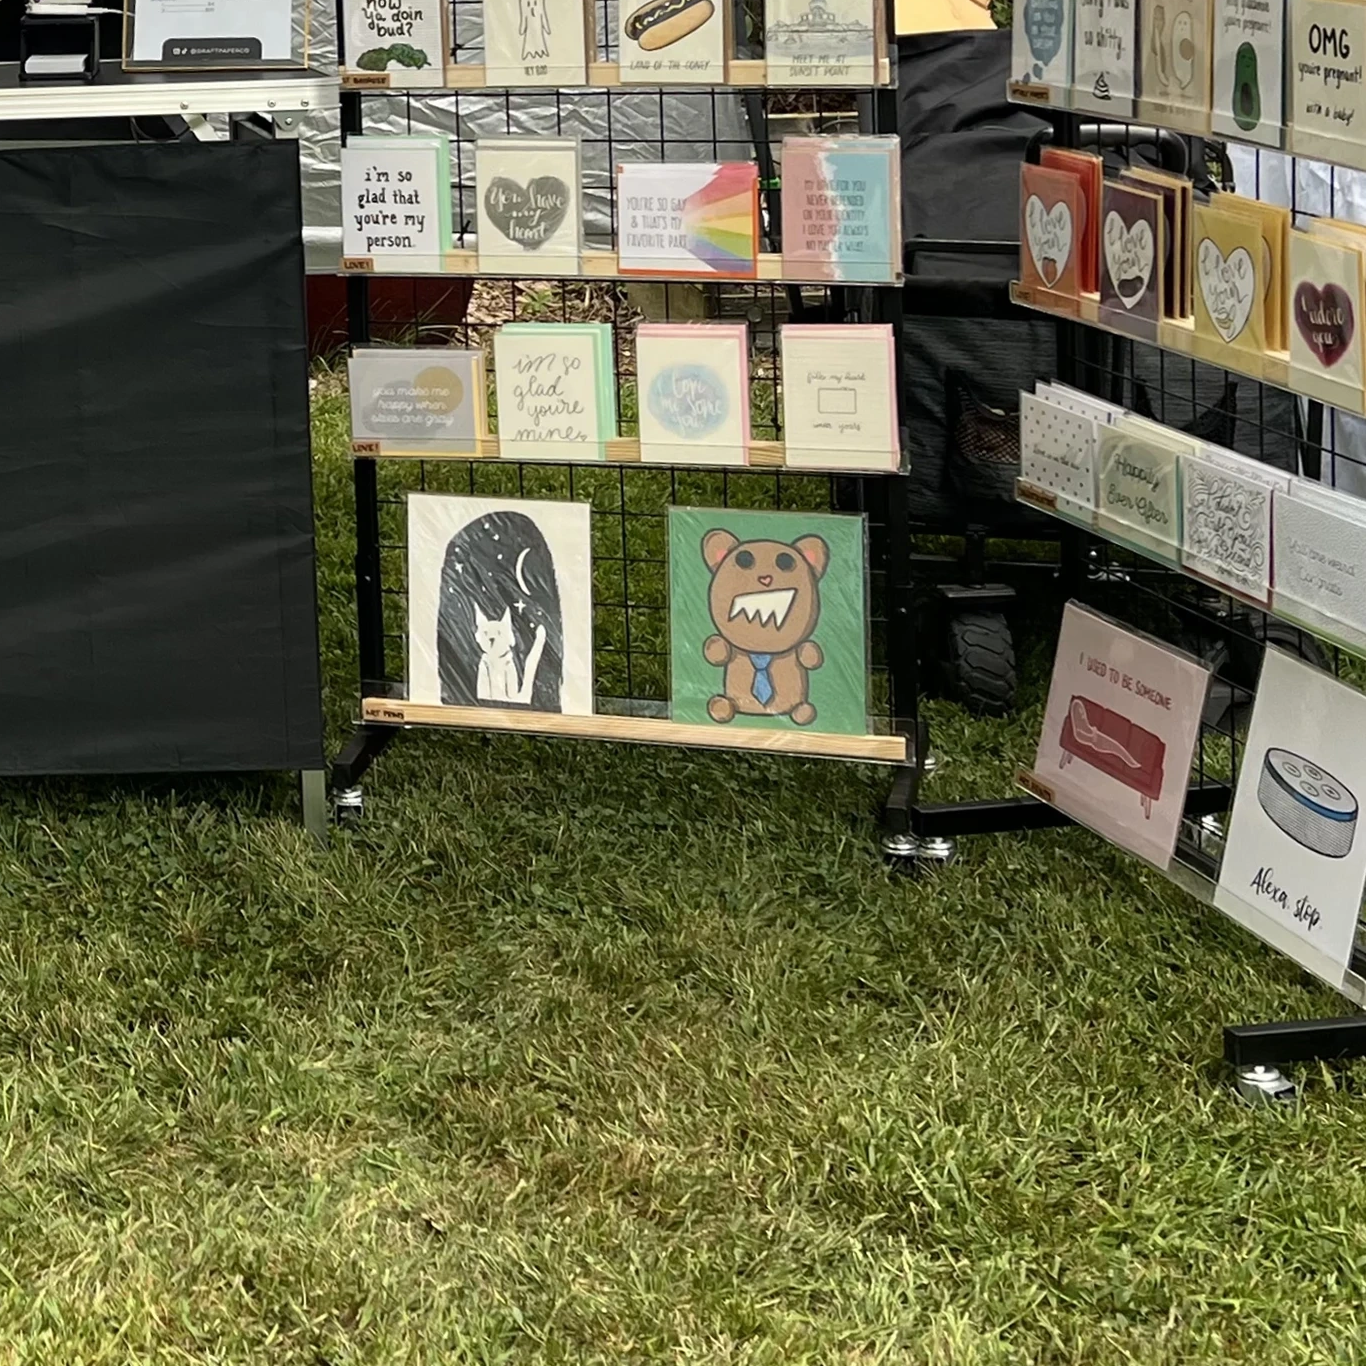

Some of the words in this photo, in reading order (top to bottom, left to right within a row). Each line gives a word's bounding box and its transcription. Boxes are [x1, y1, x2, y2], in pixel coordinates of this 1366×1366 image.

[362, 7, 386, 30] ya
[391, 6, 424, 22] doin
[376, 21, 414, 38] bud?
[1084, 31, 1093, 46] so
[1308, 23, 1350, 59] OMG
[630, 61, 650, 70] LAND
[792, 55, 814, 64] MEET
[819, 55, 832, 64] ME
[836, 54, 847, 63] AT
[1298, 61, 1322, 81] you're
[1323, 64, 1363, 89] pregnant!
[1305, 102, 1322, 115] with
[364, 167, 390, 182] i'm
[397, 171, 412, 182] so
[357, 189, 386, 209] glad
[392, 189, 421, 205] that
[626, 196, 654, 211] YOU'RE
[657, 196, 667, 211] SO
[670, 196, 686, 211] GAY
[806, 195, 826, 206] NEVER
[354, 210, 398, 232] you're
[404, 214, 426, 232] my
[630, 217, 638, 229] &
[643, 216, 667, 229] THAT'S
[670, 216, 682, 229] MY
[1040, 209, 1065, 234] love
[626, 234, 665, 248] FAVORITE
[668, 234, 687, 249] PART
[1119, 226, 1146, 253] love
[1215, 255, 1246, 285] love
[1309, 301, 1343, 326] adore
[562, 355, 581, 376] so
[514, 376, 564, 411] glad
[527, 397, 585, 426] you're
[1114, 453, 1161, 492] Happily
[1087, 656, 1106, 677] USED
[1109, 668, 1120, 684] TO
[1121, 674, 1133, 691] BE
[1135, 681, 1172, 710] SOMEONE
